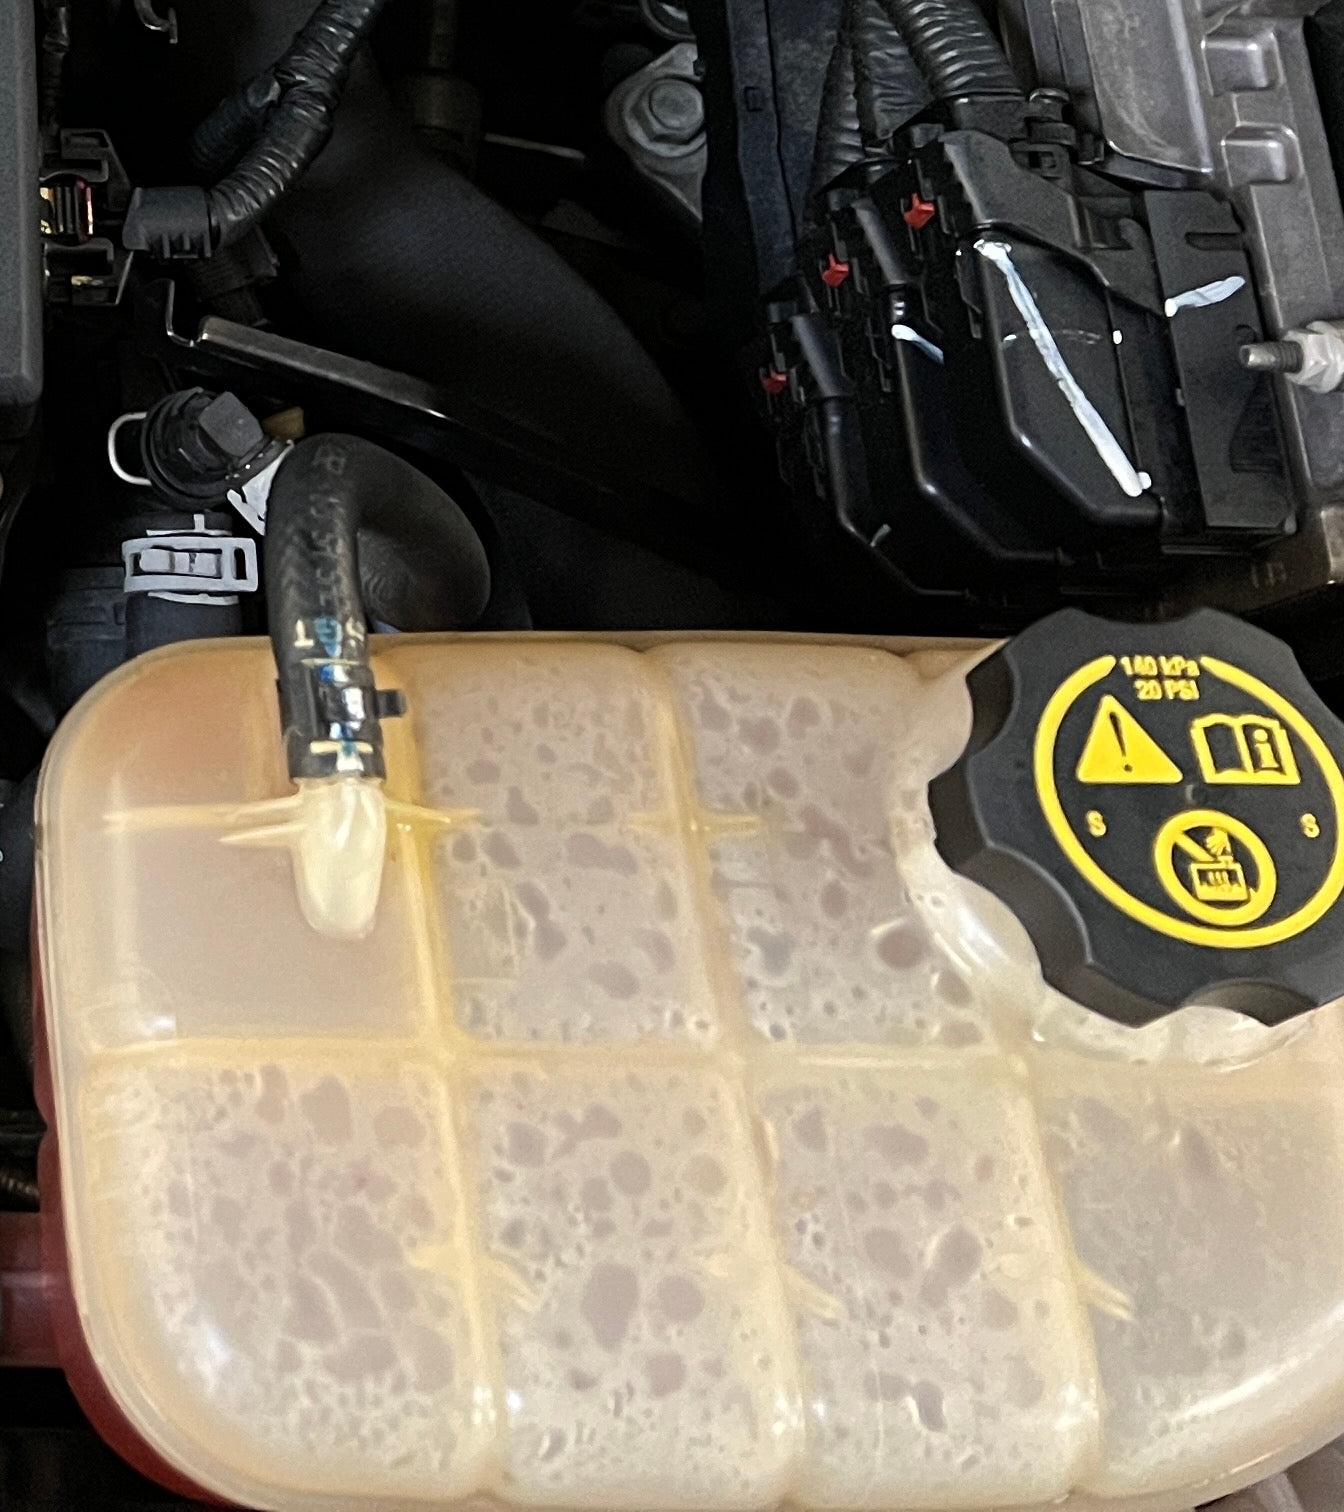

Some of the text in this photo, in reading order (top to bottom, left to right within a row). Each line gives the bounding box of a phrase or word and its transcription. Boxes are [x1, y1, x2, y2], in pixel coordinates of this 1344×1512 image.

[1159, 656, 1201, 675] kPa
[1134, 678, 1200, 701] 20 PSI
